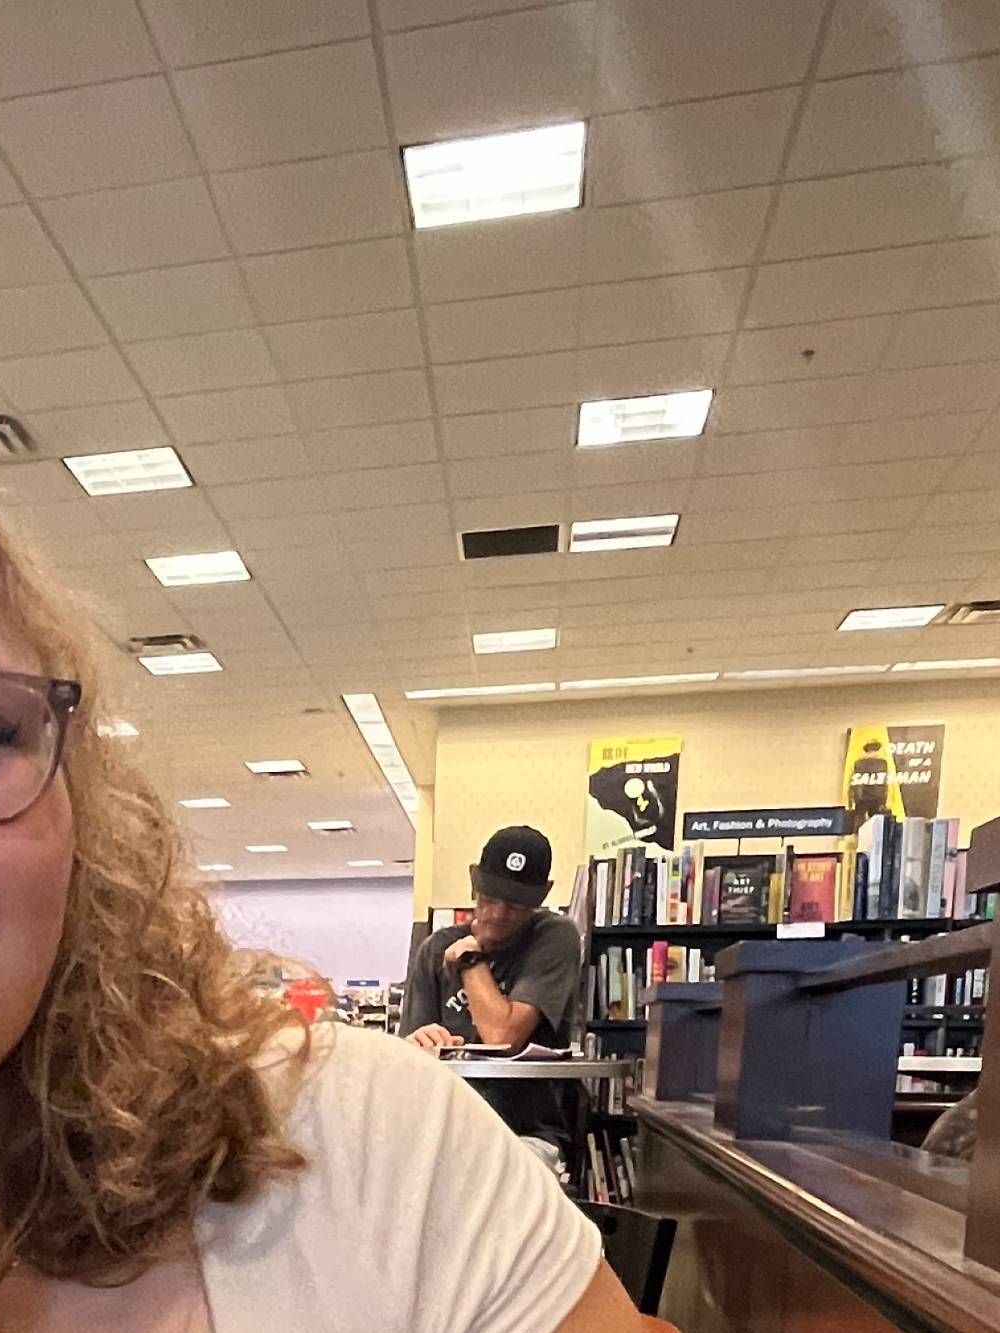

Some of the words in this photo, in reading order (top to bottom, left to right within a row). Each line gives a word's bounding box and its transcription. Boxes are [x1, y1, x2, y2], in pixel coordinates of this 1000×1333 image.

[885, 741, 936, 755] DEATH
[713, 820, 753, 831] Fashion
[755, 818, 765, 829] &
[767, 817, 834, 831] Photography
